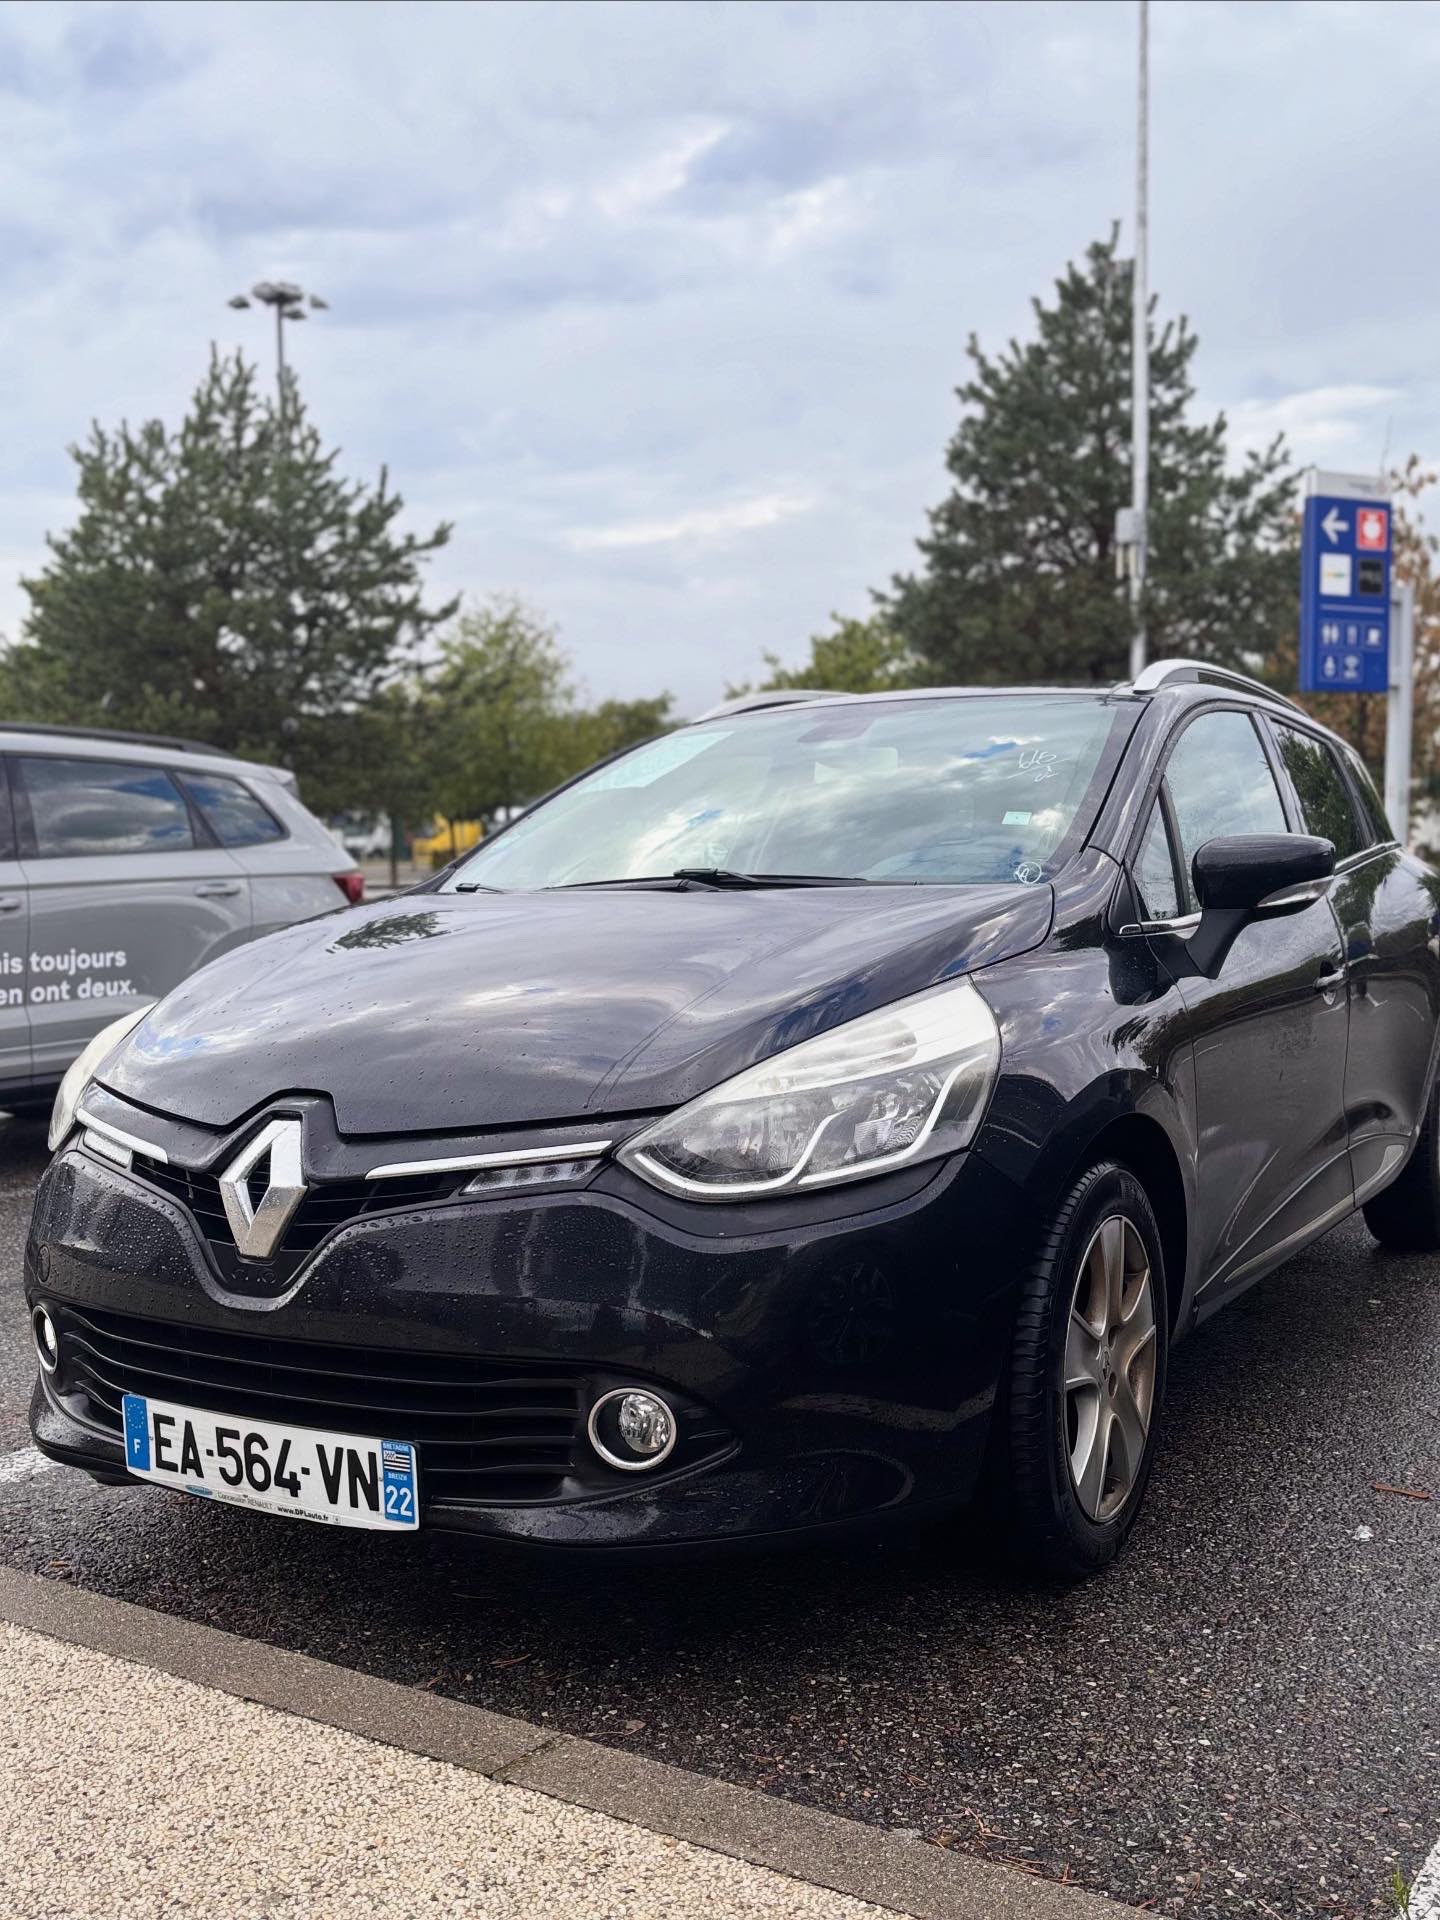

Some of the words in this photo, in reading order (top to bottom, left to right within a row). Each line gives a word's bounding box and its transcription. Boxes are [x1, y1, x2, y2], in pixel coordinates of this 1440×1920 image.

[0, 952, 23, 974] is
[30, 948, 127, 975] toujours
[30, 980, 70, 1003] ont
[77, 977, 137, 999] deux.
[134, 1438, 141, 1454] F
[153, 1412, 380, 1512] EA-564-VN
[385, 1485, 413, 1517] 22
